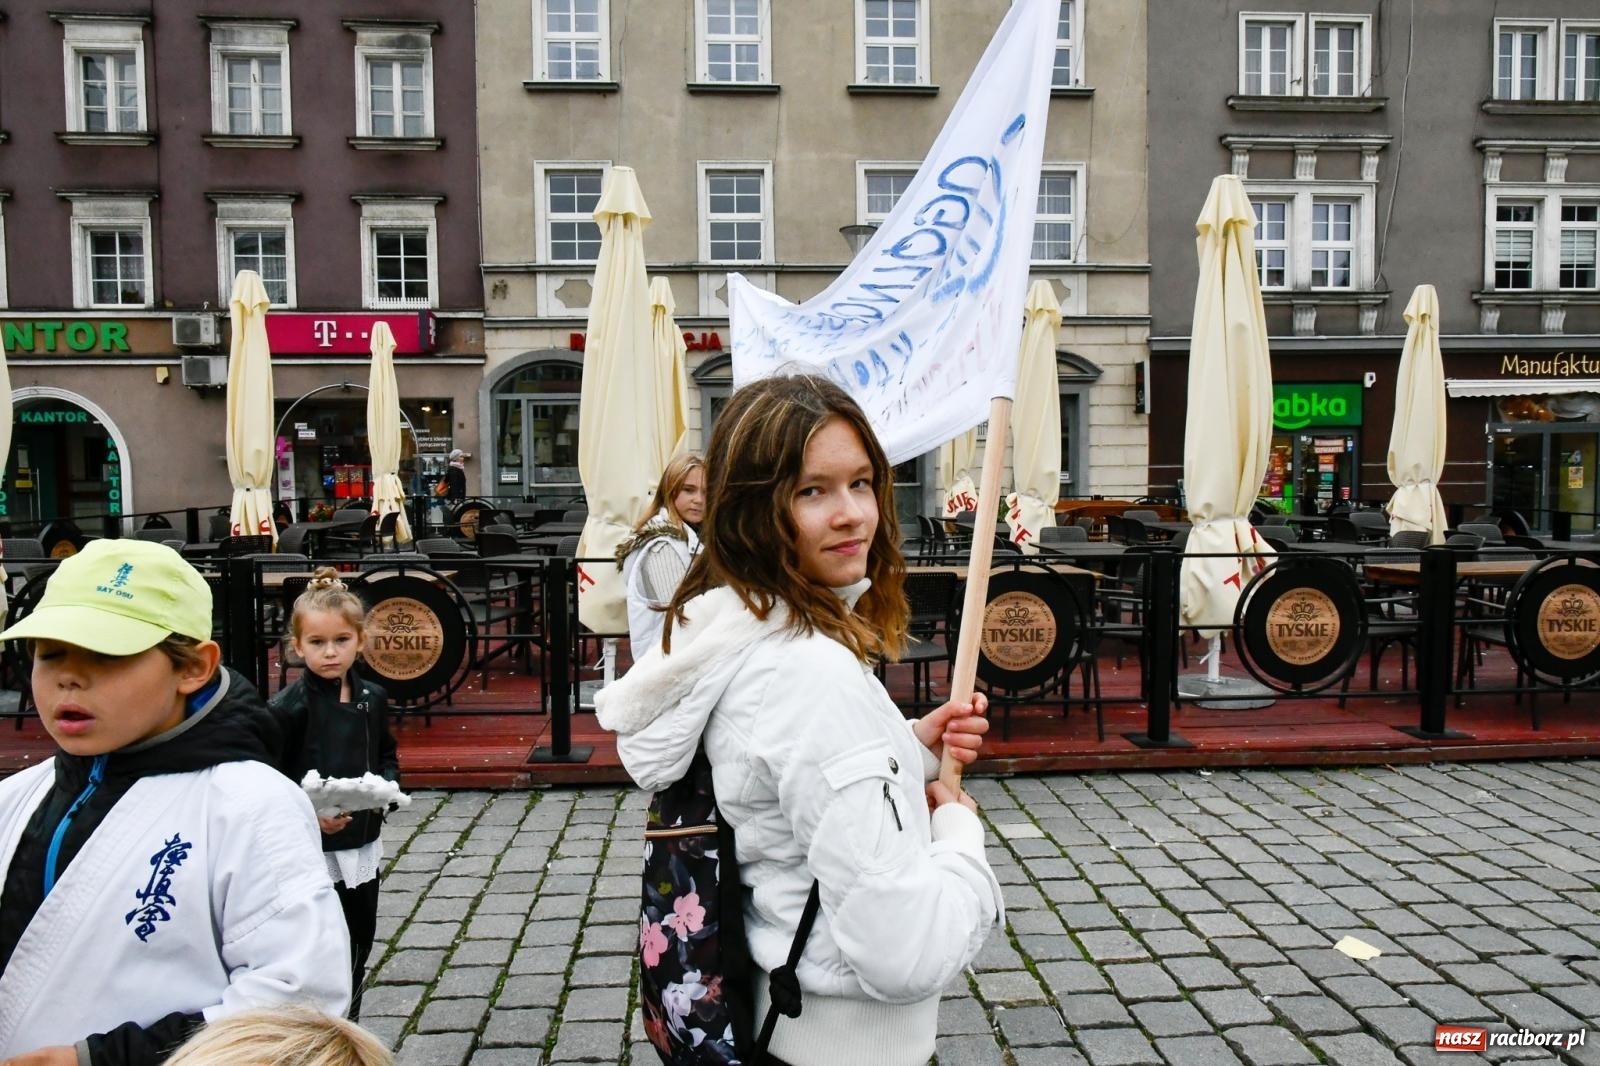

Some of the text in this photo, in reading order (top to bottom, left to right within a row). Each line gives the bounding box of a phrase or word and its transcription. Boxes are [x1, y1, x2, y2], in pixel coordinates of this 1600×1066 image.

[4, 321, 130, 351] NTOR
[1501, 352, 1600, 376] Manufaktu
[1273, 392, 1347, 417] abka
[21, 411, 87, 422] KANTOR
[96, 585, 134, 600] SAY OSU
[1276, 623, 1329, 637] TYSKIE
[1546, 618, 1597, 632] TYSKIE
[373, 635, 431, 650] TYSKIE
[988, 628, 1045, 643] TYSKIE
